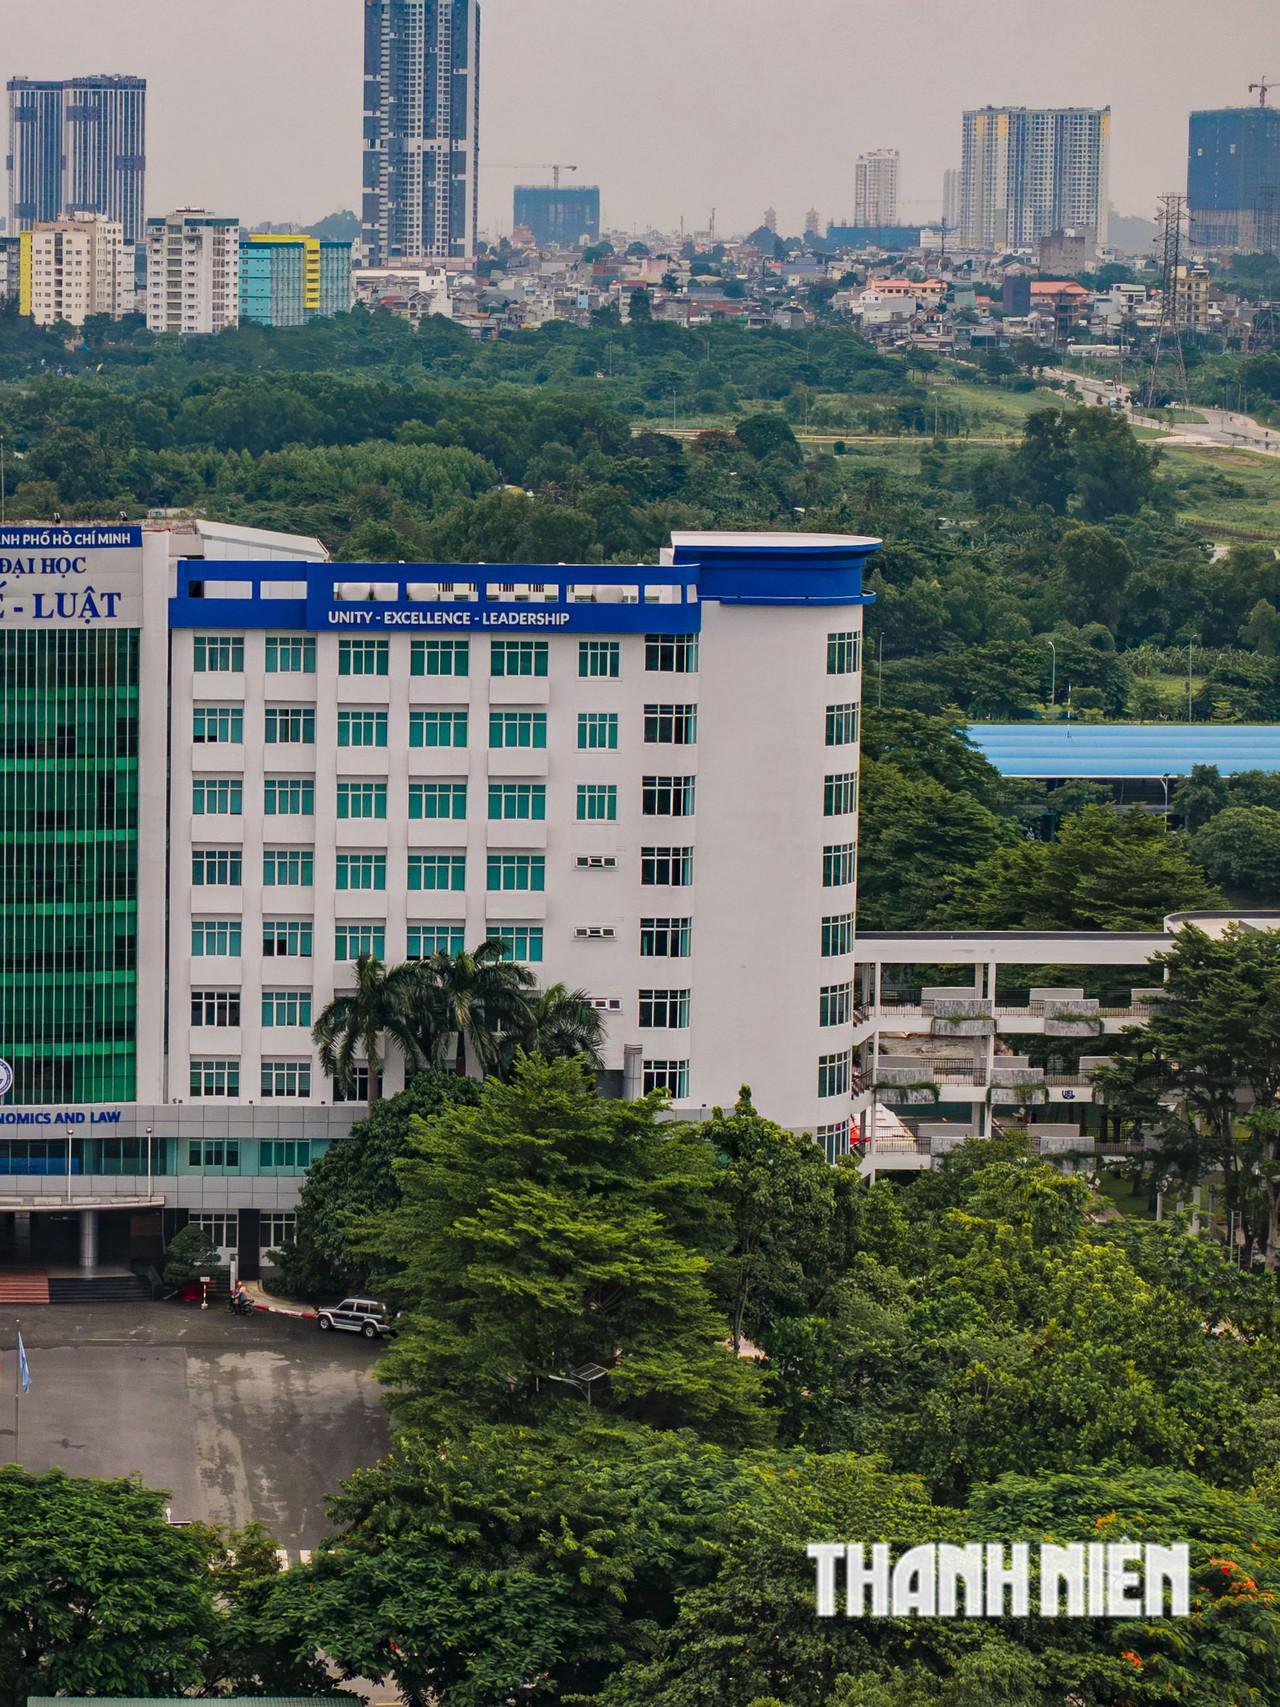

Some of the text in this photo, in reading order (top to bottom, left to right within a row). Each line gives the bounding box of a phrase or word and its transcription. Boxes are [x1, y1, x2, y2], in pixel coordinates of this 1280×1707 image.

[23, 530, 50, 545] PHỐ
[53, 530, 72, 545] HỒ
[74, 530, 96, 545] CHÍ
[98, 533, 131, 545] MINH
[41, 557, 86, 578] HỌC
[32, 586, 122, 624] LUẬT
[328, 611, 373, 625] UNITY
[383, 611, 471, 625] EXCELLENCE
[482, 612, 570, 626] LEADERSHIP
[54, 1112, 85, 1124] AND
[90, 1111, 121, 1123] LAW
